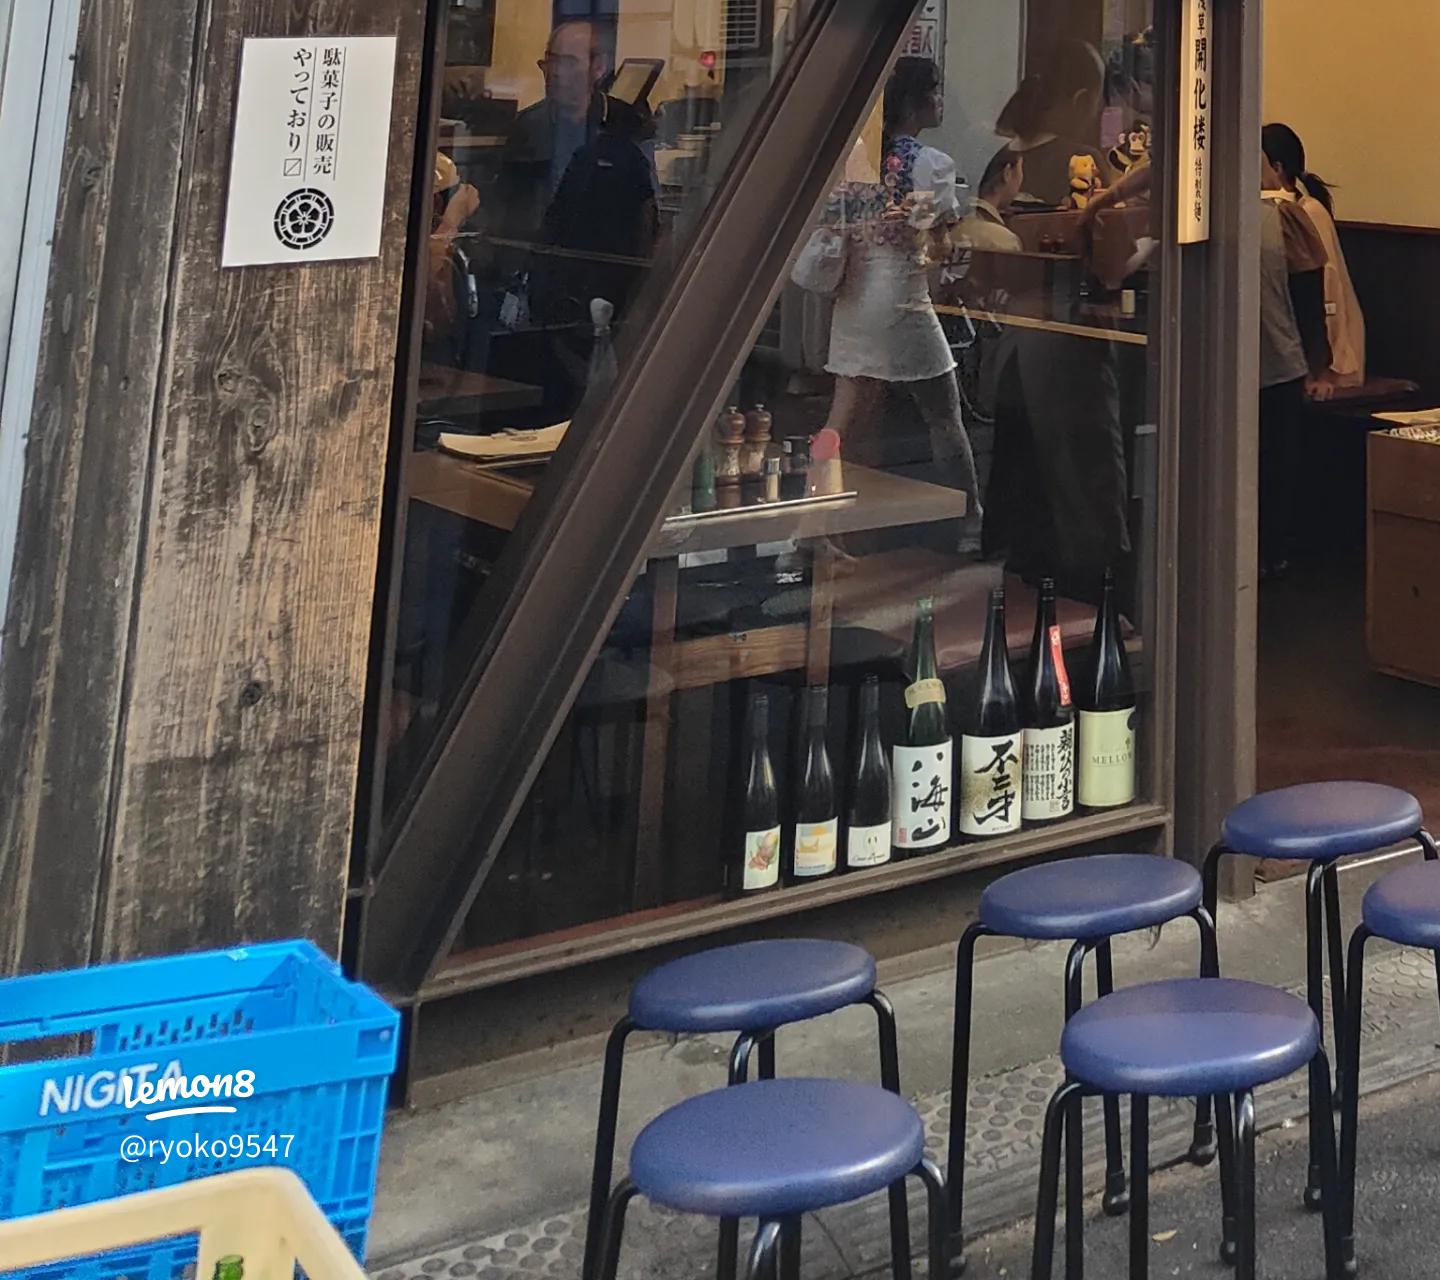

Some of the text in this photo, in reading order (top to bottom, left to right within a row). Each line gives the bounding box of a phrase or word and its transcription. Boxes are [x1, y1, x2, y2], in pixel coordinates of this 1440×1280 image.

[313, 47, 342, 175] 駄菓子の販売
[911, 751, 949, 842] 八海山
